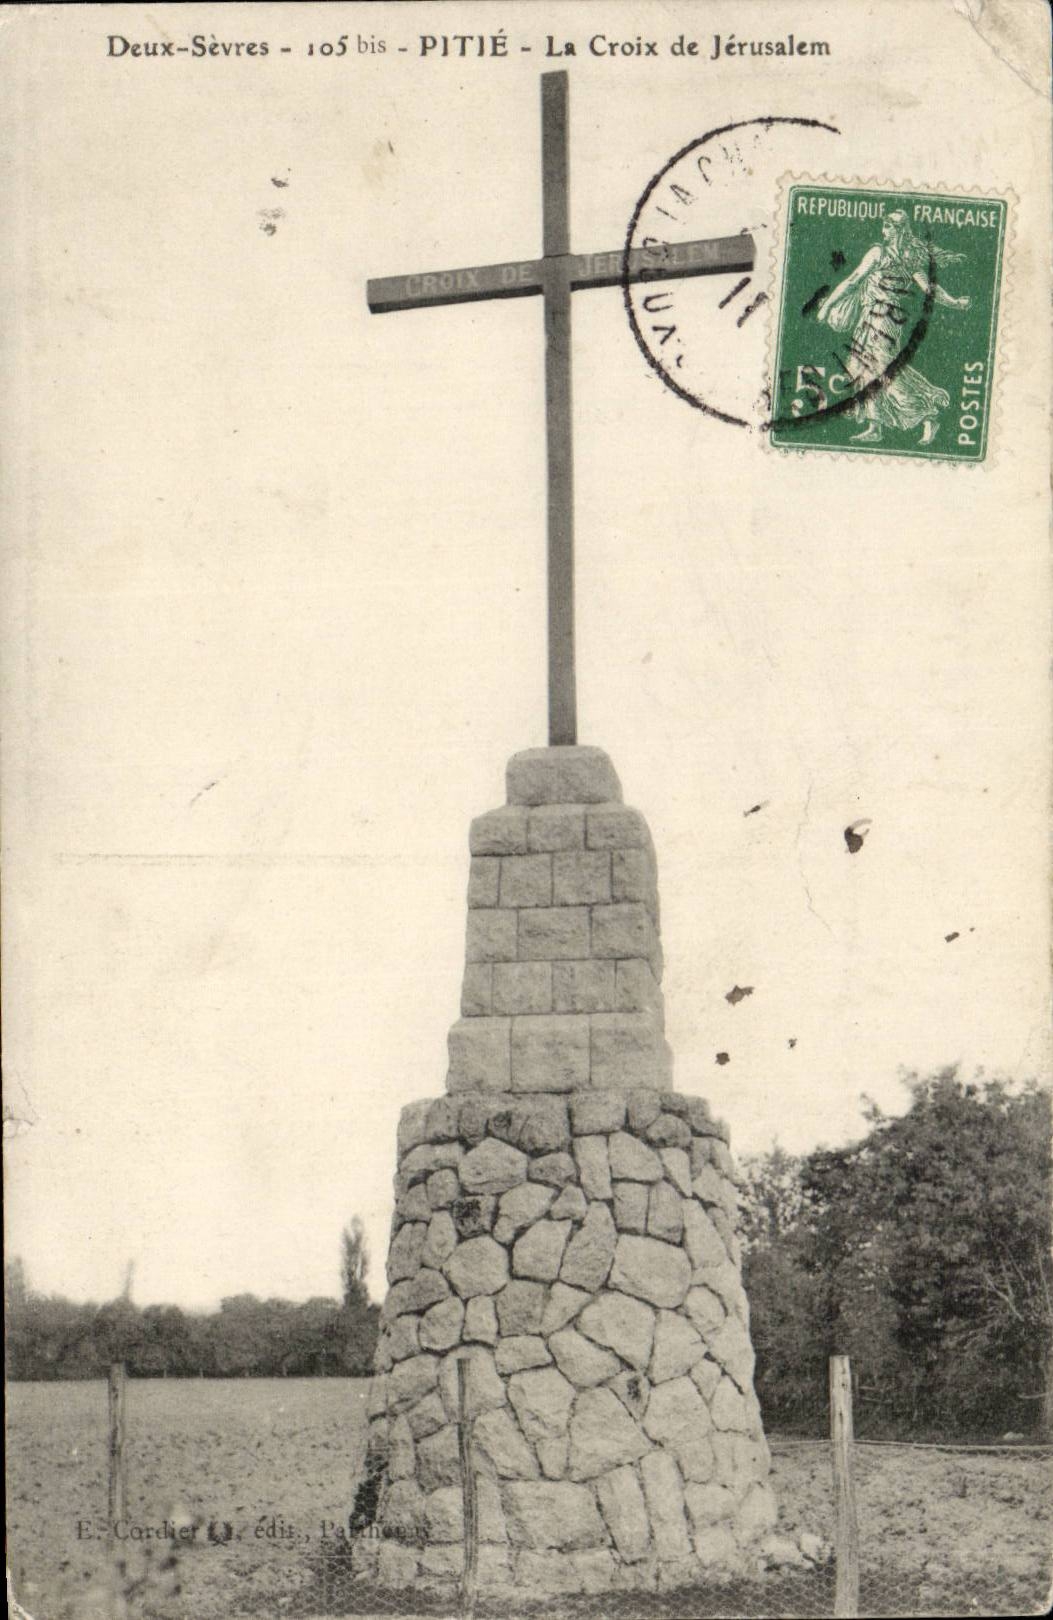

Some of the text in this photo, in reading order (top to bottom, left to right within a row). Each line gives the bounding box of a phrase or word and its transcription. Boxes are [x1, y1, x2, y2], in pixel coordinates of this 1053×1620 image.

[914, 204, 998, 228] FRANÇAISE
[404, 268, 481, 299] CROIX
[500, 264, 534, 285] DE
[957, 361, 984, 446] POSTES
